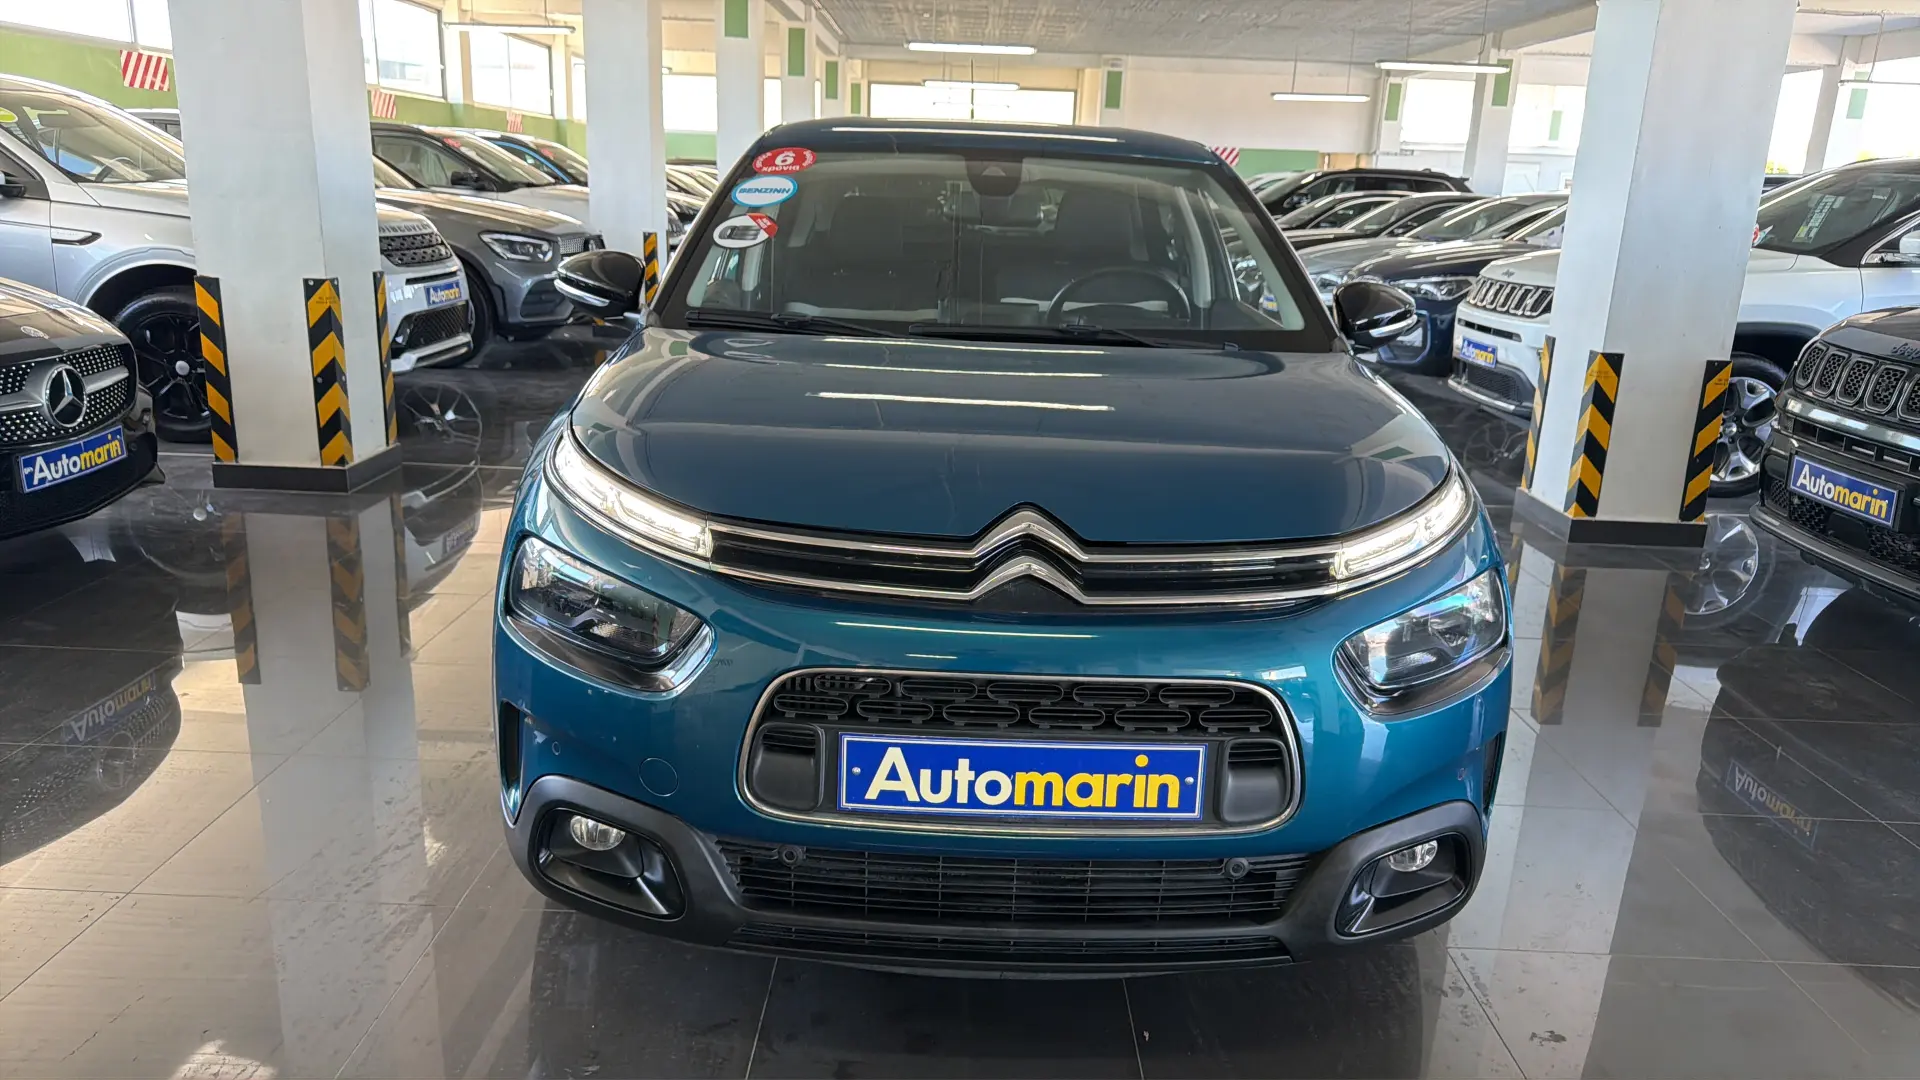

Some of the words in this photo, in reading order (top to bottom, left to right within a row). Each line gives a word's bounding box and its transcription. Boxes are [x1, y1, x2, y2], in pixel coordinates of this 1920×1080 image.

[775, 152, 795, 166] 6
[33, 433, 121, 485] Automarin
[1797, 464, 1887, 519] Automarin
[864, 747, 1180, 808] Automarin
